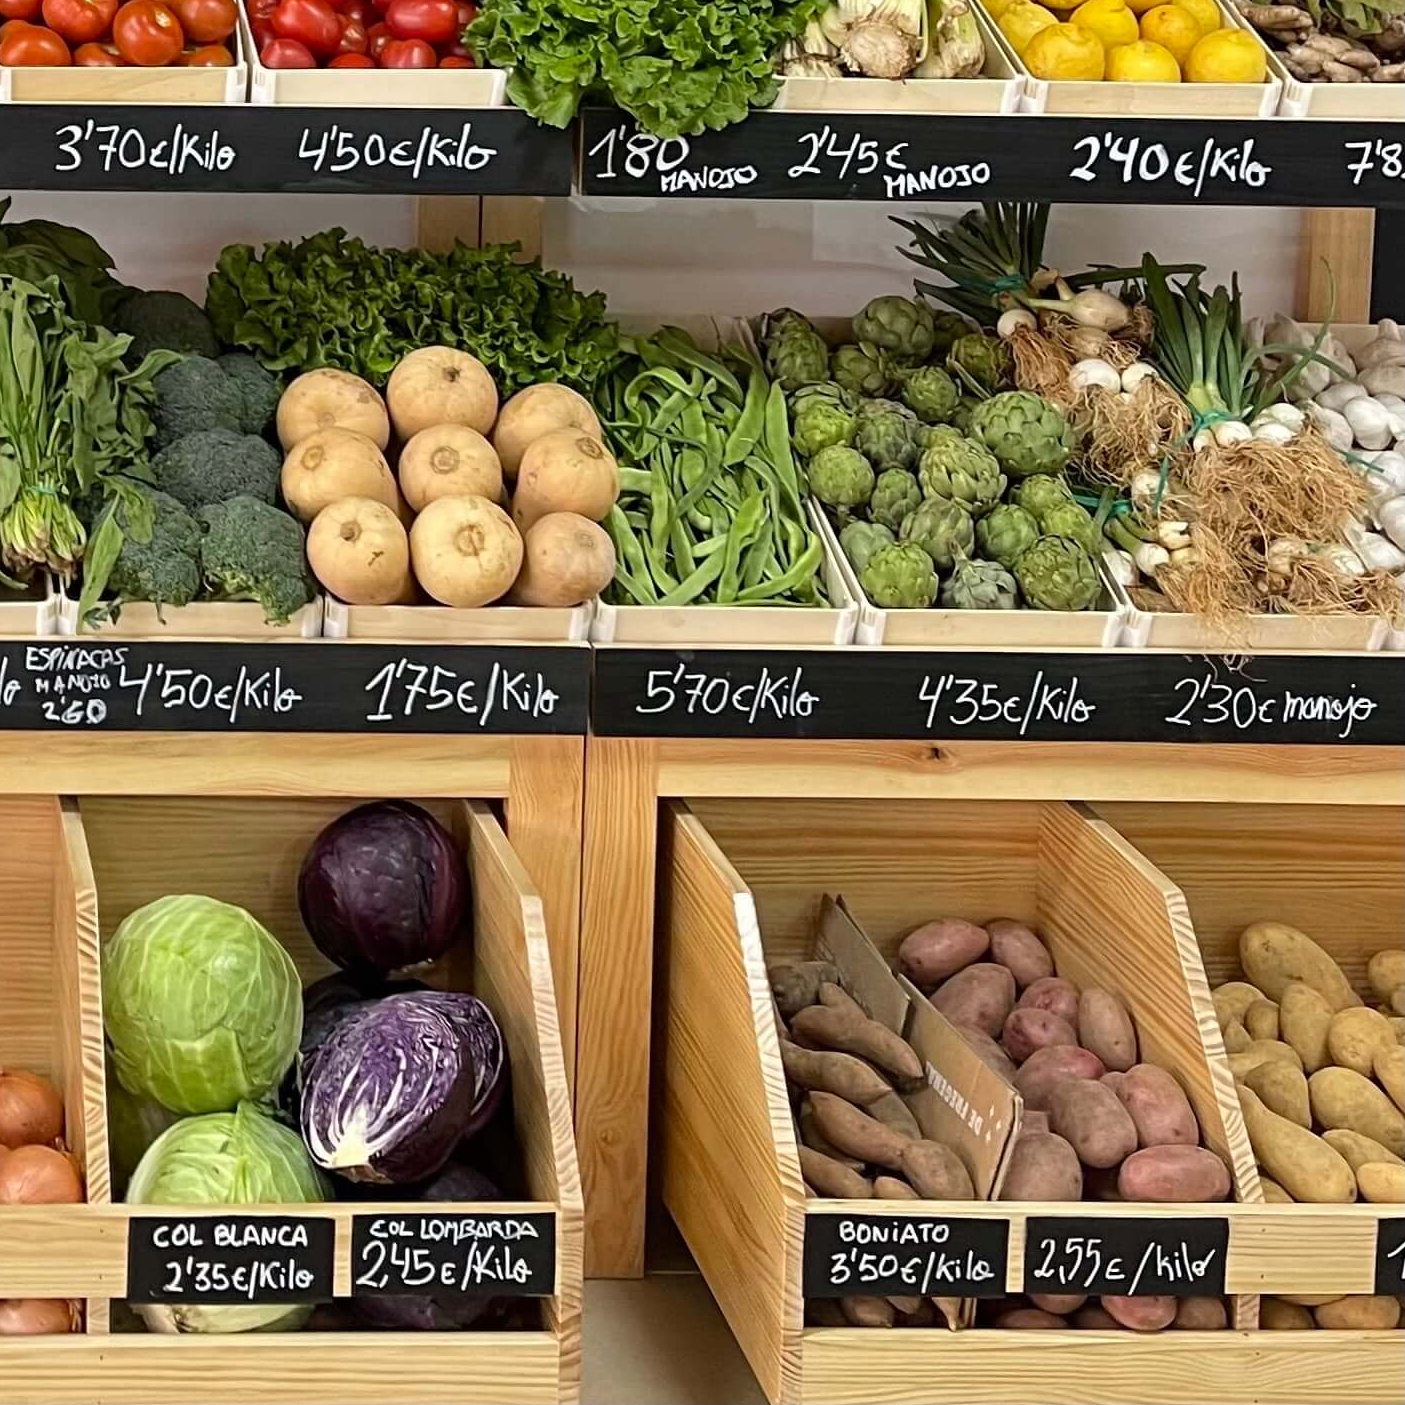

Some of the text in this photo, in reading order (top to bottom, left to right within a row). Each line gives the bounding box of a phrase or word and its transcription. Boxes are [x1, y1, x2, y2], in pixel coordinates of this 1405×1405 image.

[55, 119, 236, 175] 3'70€/Kilo
[298, 122, 497, 179] 4'50€/Kilo
[588, 124, 690, 178] 1'80
[1069, 131, 1272, 197] 2'40€/Kilo
[660, 165, 758, 192] MANOJO
[883, 162, 990, 198] MANOJO
[119, 663, 303, 723] 4'50€/Kilo
[365, 658, 560, 726] 1'75€/Kilo
[635, 663, 820, 724] 5'70€/Kilo
[919, 670, 1096, 735] 4'35€/Kilo
[1283, 683, 1378, 738] manojo
[153, 1223, 308, 1248] COL BLANCA
[420, 1218, 539, 1246] LOMBARDA
[163, 1255, 314, 1299] 2'35€/Kilo
